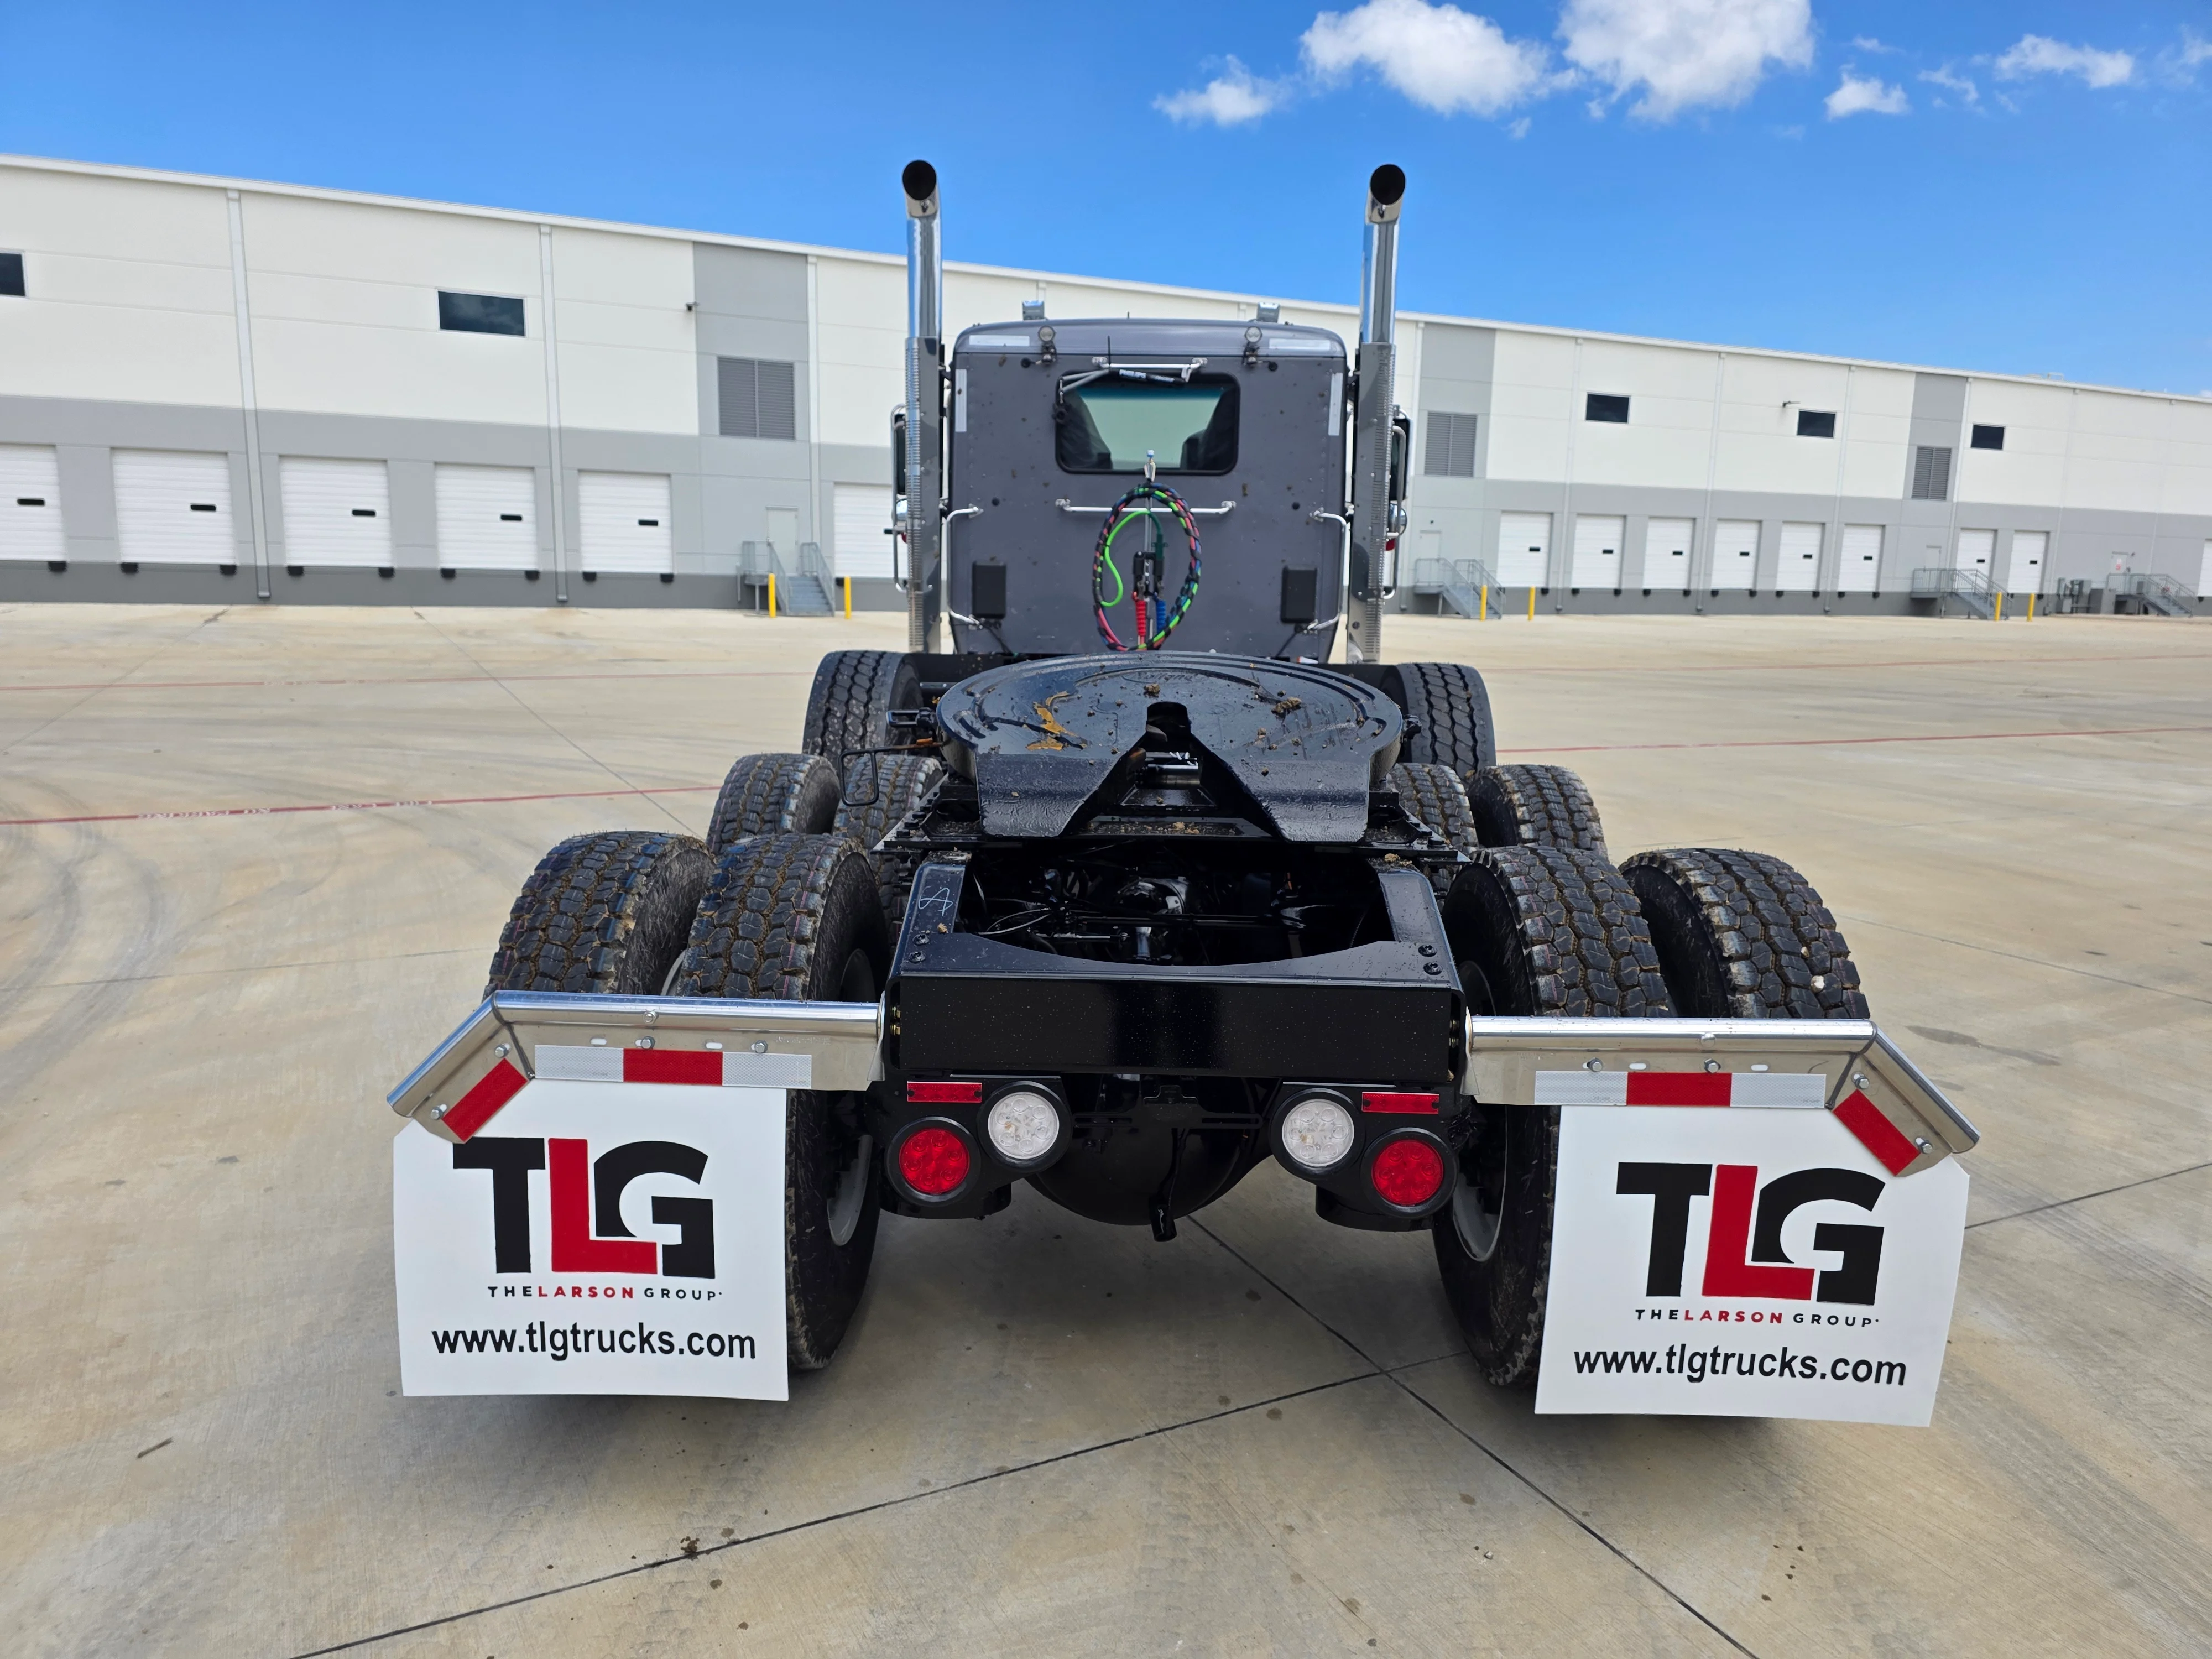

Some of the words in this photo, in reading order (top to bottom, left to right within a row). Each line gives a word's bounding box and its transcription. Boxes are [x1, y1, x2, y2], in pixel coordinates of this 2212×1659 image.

[453, 1136, 716, 1279] TLG
[1616, 1162, 1886, 1306] TLG
[644, 1287, 717, 1301] GROUP
[431, 1321, 757, 1361] www.tlgtrucks.com
[1793, 1313, 1872, 1328] GROUP
[1573, 1343, 1907, 1387] www.tlgtrucks.com
